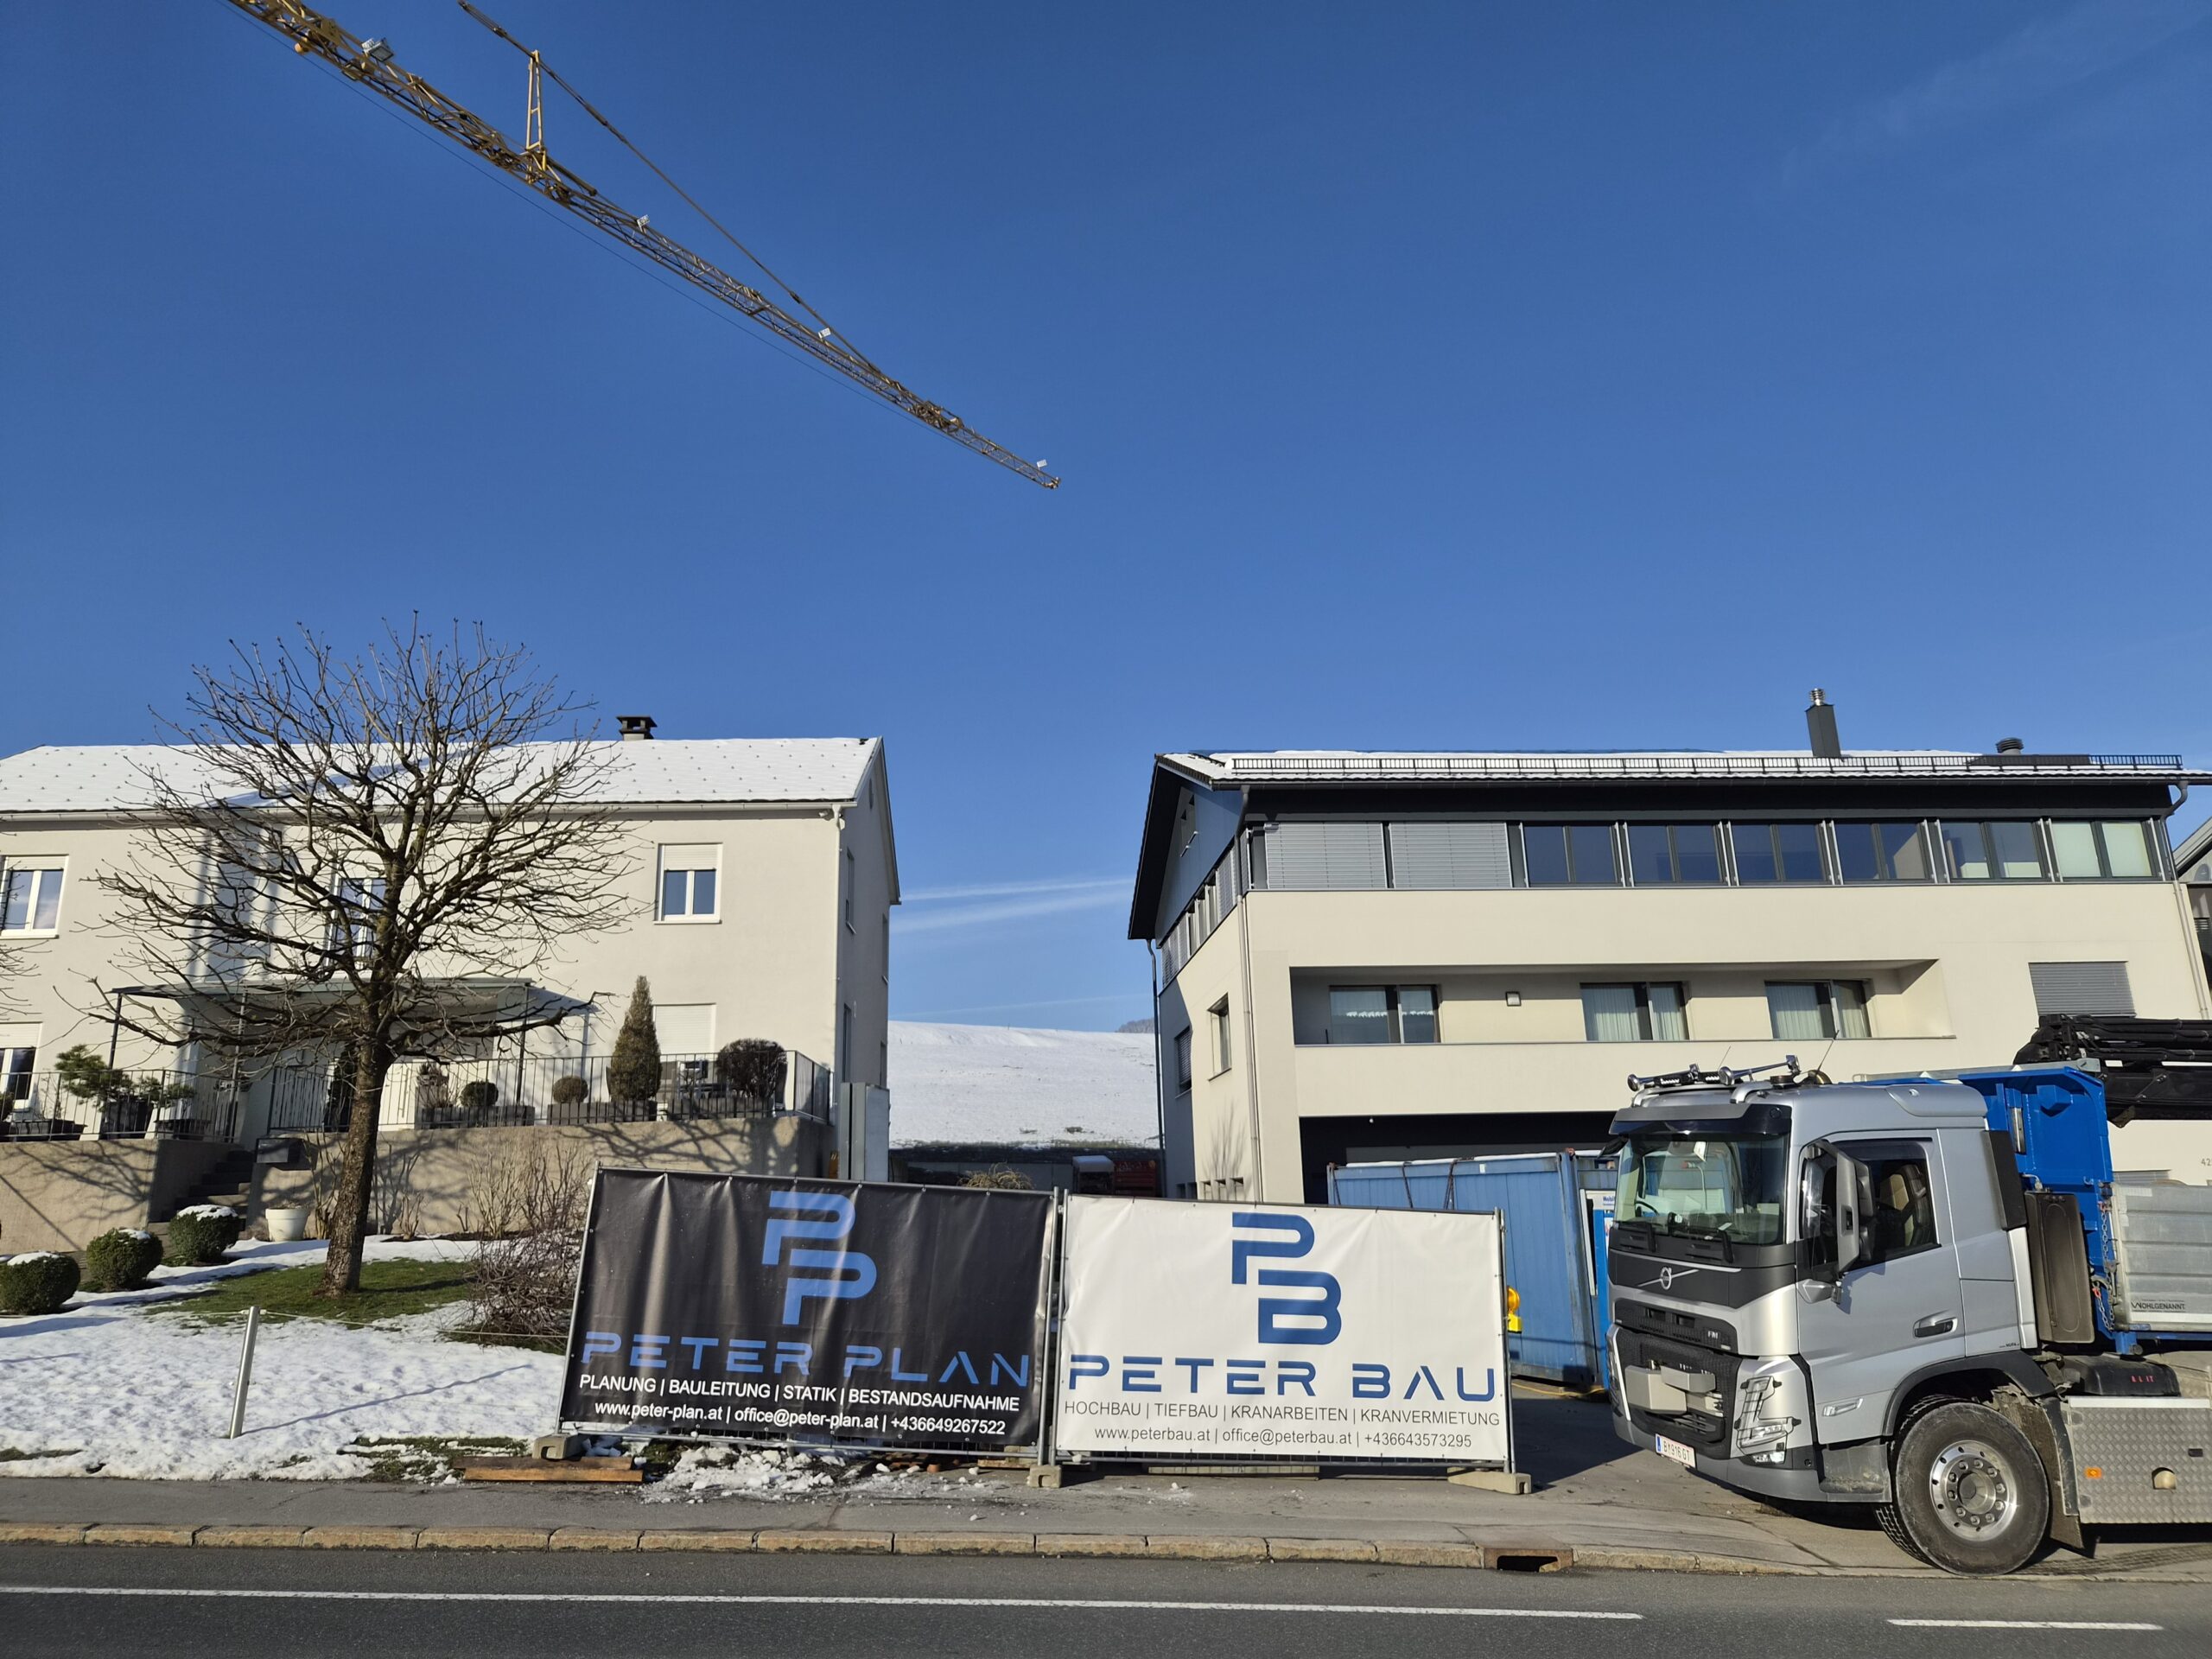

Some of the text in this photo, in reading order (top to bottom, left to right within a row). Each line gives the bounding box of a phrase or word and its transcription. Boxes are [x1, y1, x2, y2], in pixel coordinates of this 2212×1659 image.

[2131, 1301, 2185, 1310] WOHLGENANNT
[1707, 1330, 1719, 1339] FM
[581, 1331, 1029, 1387] PETER PLAN
[1069, 1354, 1496, 1402] PETER BAU
[579, 1374, 657, 1393] PLANUNG
[669, 1379, 771, 1399] BAULEITUNG
[783, 1385, 837, 1402] STATIK
[848, 1389, 1020, 1412] BESTANDSAUFNAHME
[594, 1403, 722, 1421] www.peter-plan.at
[734, 1407, 879, 1429] office@peter-plan.at
[890, 1415, 1006, 1435] +436649267522
[1065, 1401, 1141, 1416] HOCHBAU
[1154, 1402, 1218, 1418] TIEFBAU
[1231, 1405, 1348, 1421] KRANARBEITEN
[1361, 1408, 1500, 1426] KRANVERMIETUNG
[1095, 1427, 1211, 1442] www.peterbau.at
[1223, 1428, 1352, 1446] office@peterbau.at
[1364, 1432, 1471, 1448] +436643573295
